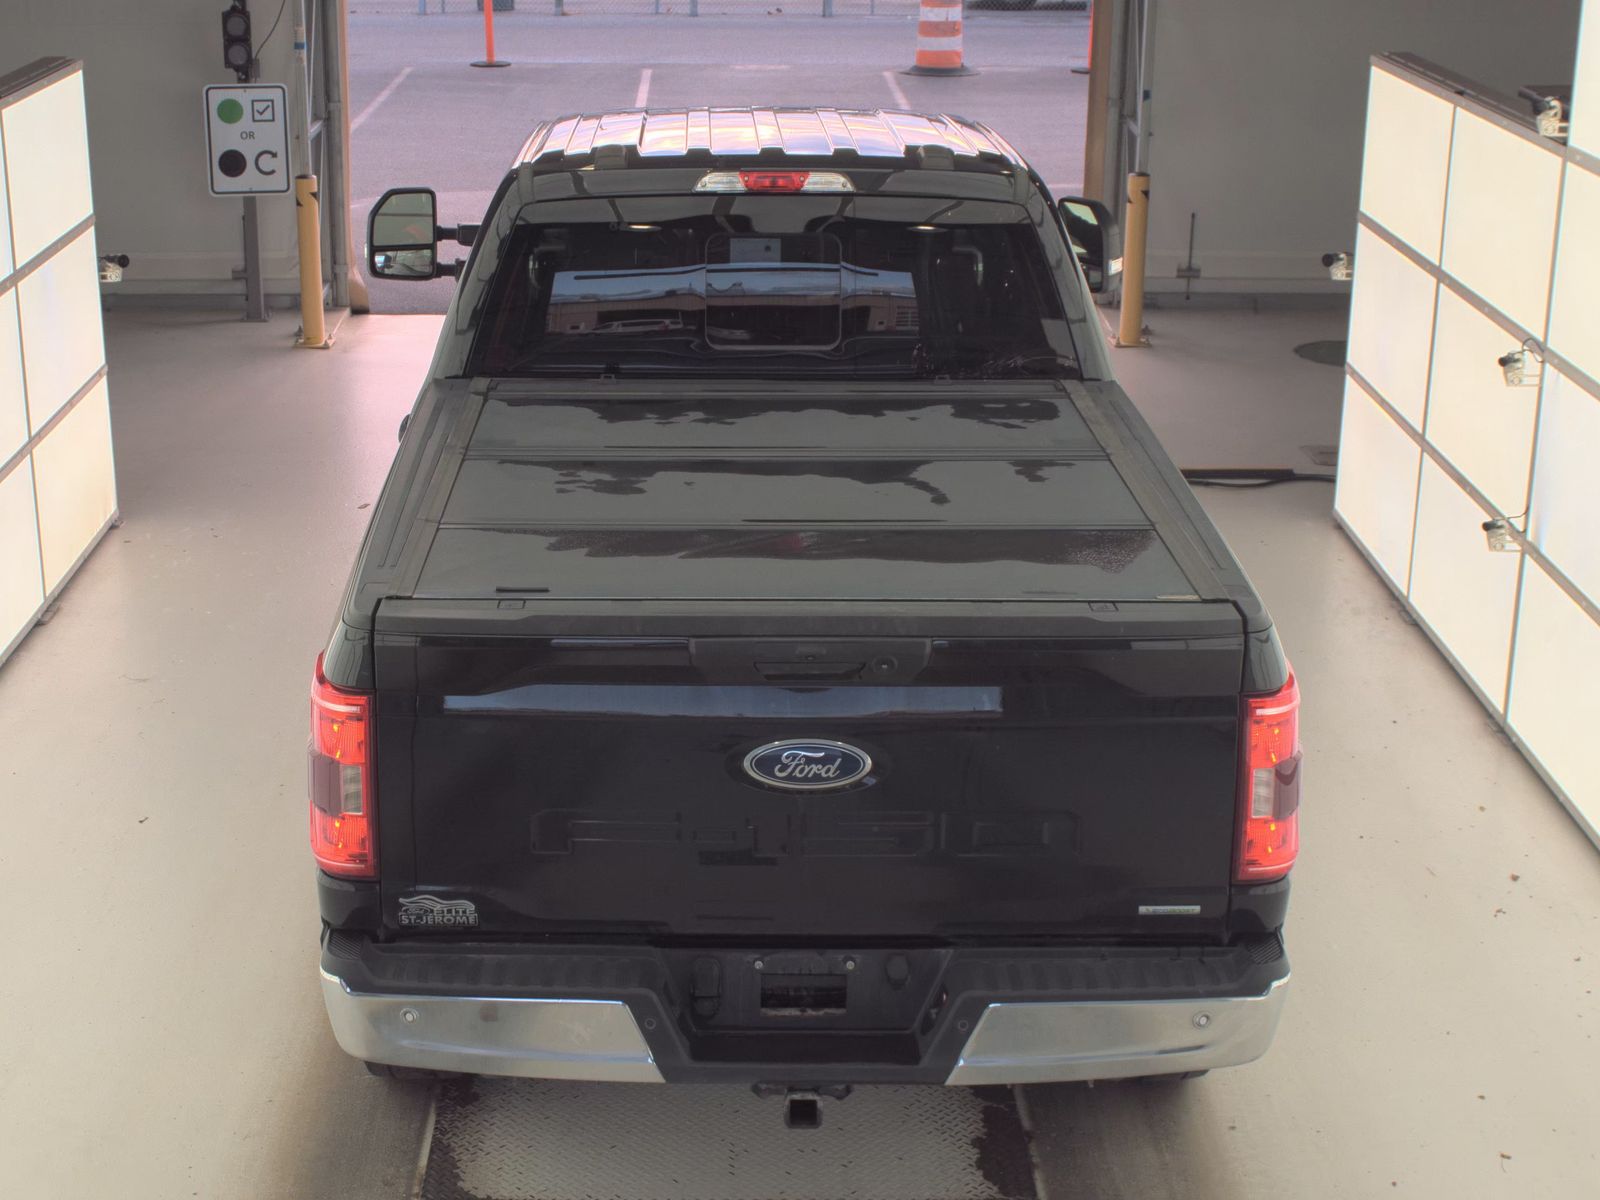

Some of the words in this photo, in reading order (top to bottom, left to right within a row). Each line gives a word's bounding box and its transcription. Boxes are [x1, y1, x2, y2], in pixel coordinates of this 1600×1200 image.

[240, 131, 256, 140] OR
[774, 750, 842, 778] Ford
[433, 907, 476, 917] ELITE
